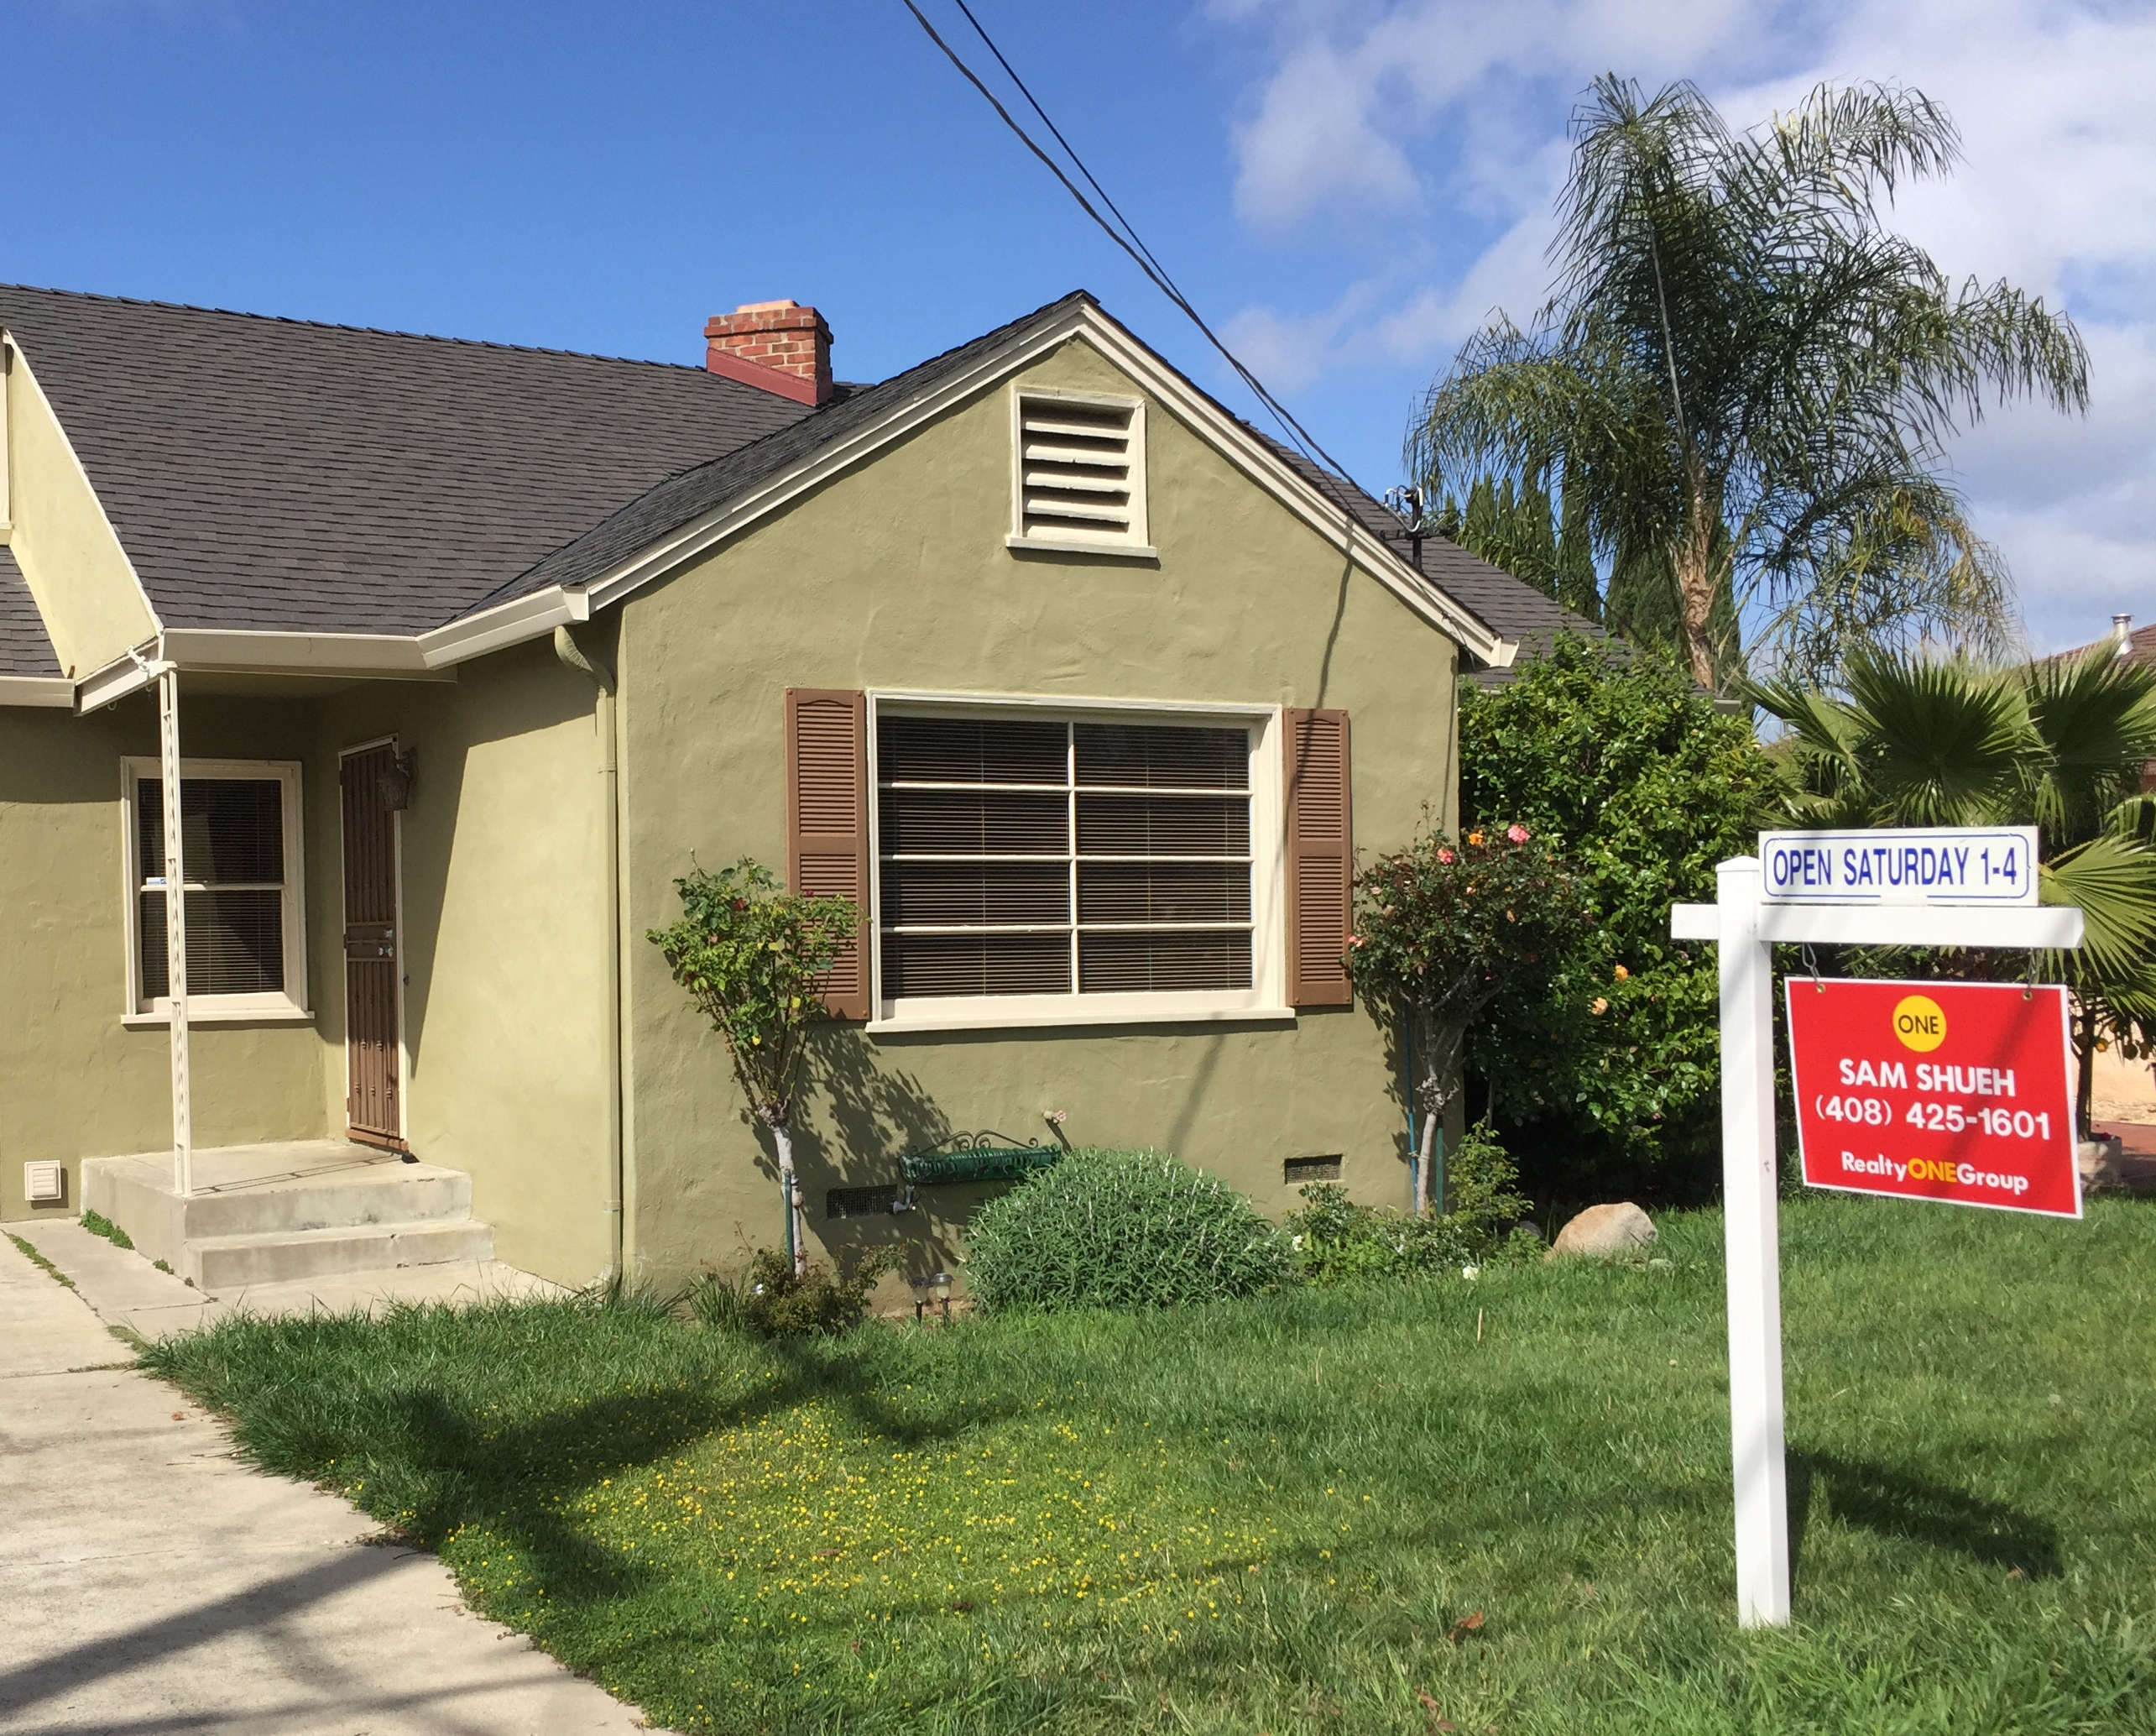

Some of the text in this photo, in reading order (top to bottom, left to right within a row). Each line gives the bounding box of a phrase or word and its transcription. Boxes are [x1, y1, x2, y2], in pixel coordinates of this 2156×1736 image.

[1773, 847, 2018, 886] OPEN SATURDAY 1-4
[1898, 1014, 1940, 1035] ONE
[1839, 1058, 2016, 1097] SAM SHUEH
[1815, 1094, 2050, 1140] (408) 425-1601
